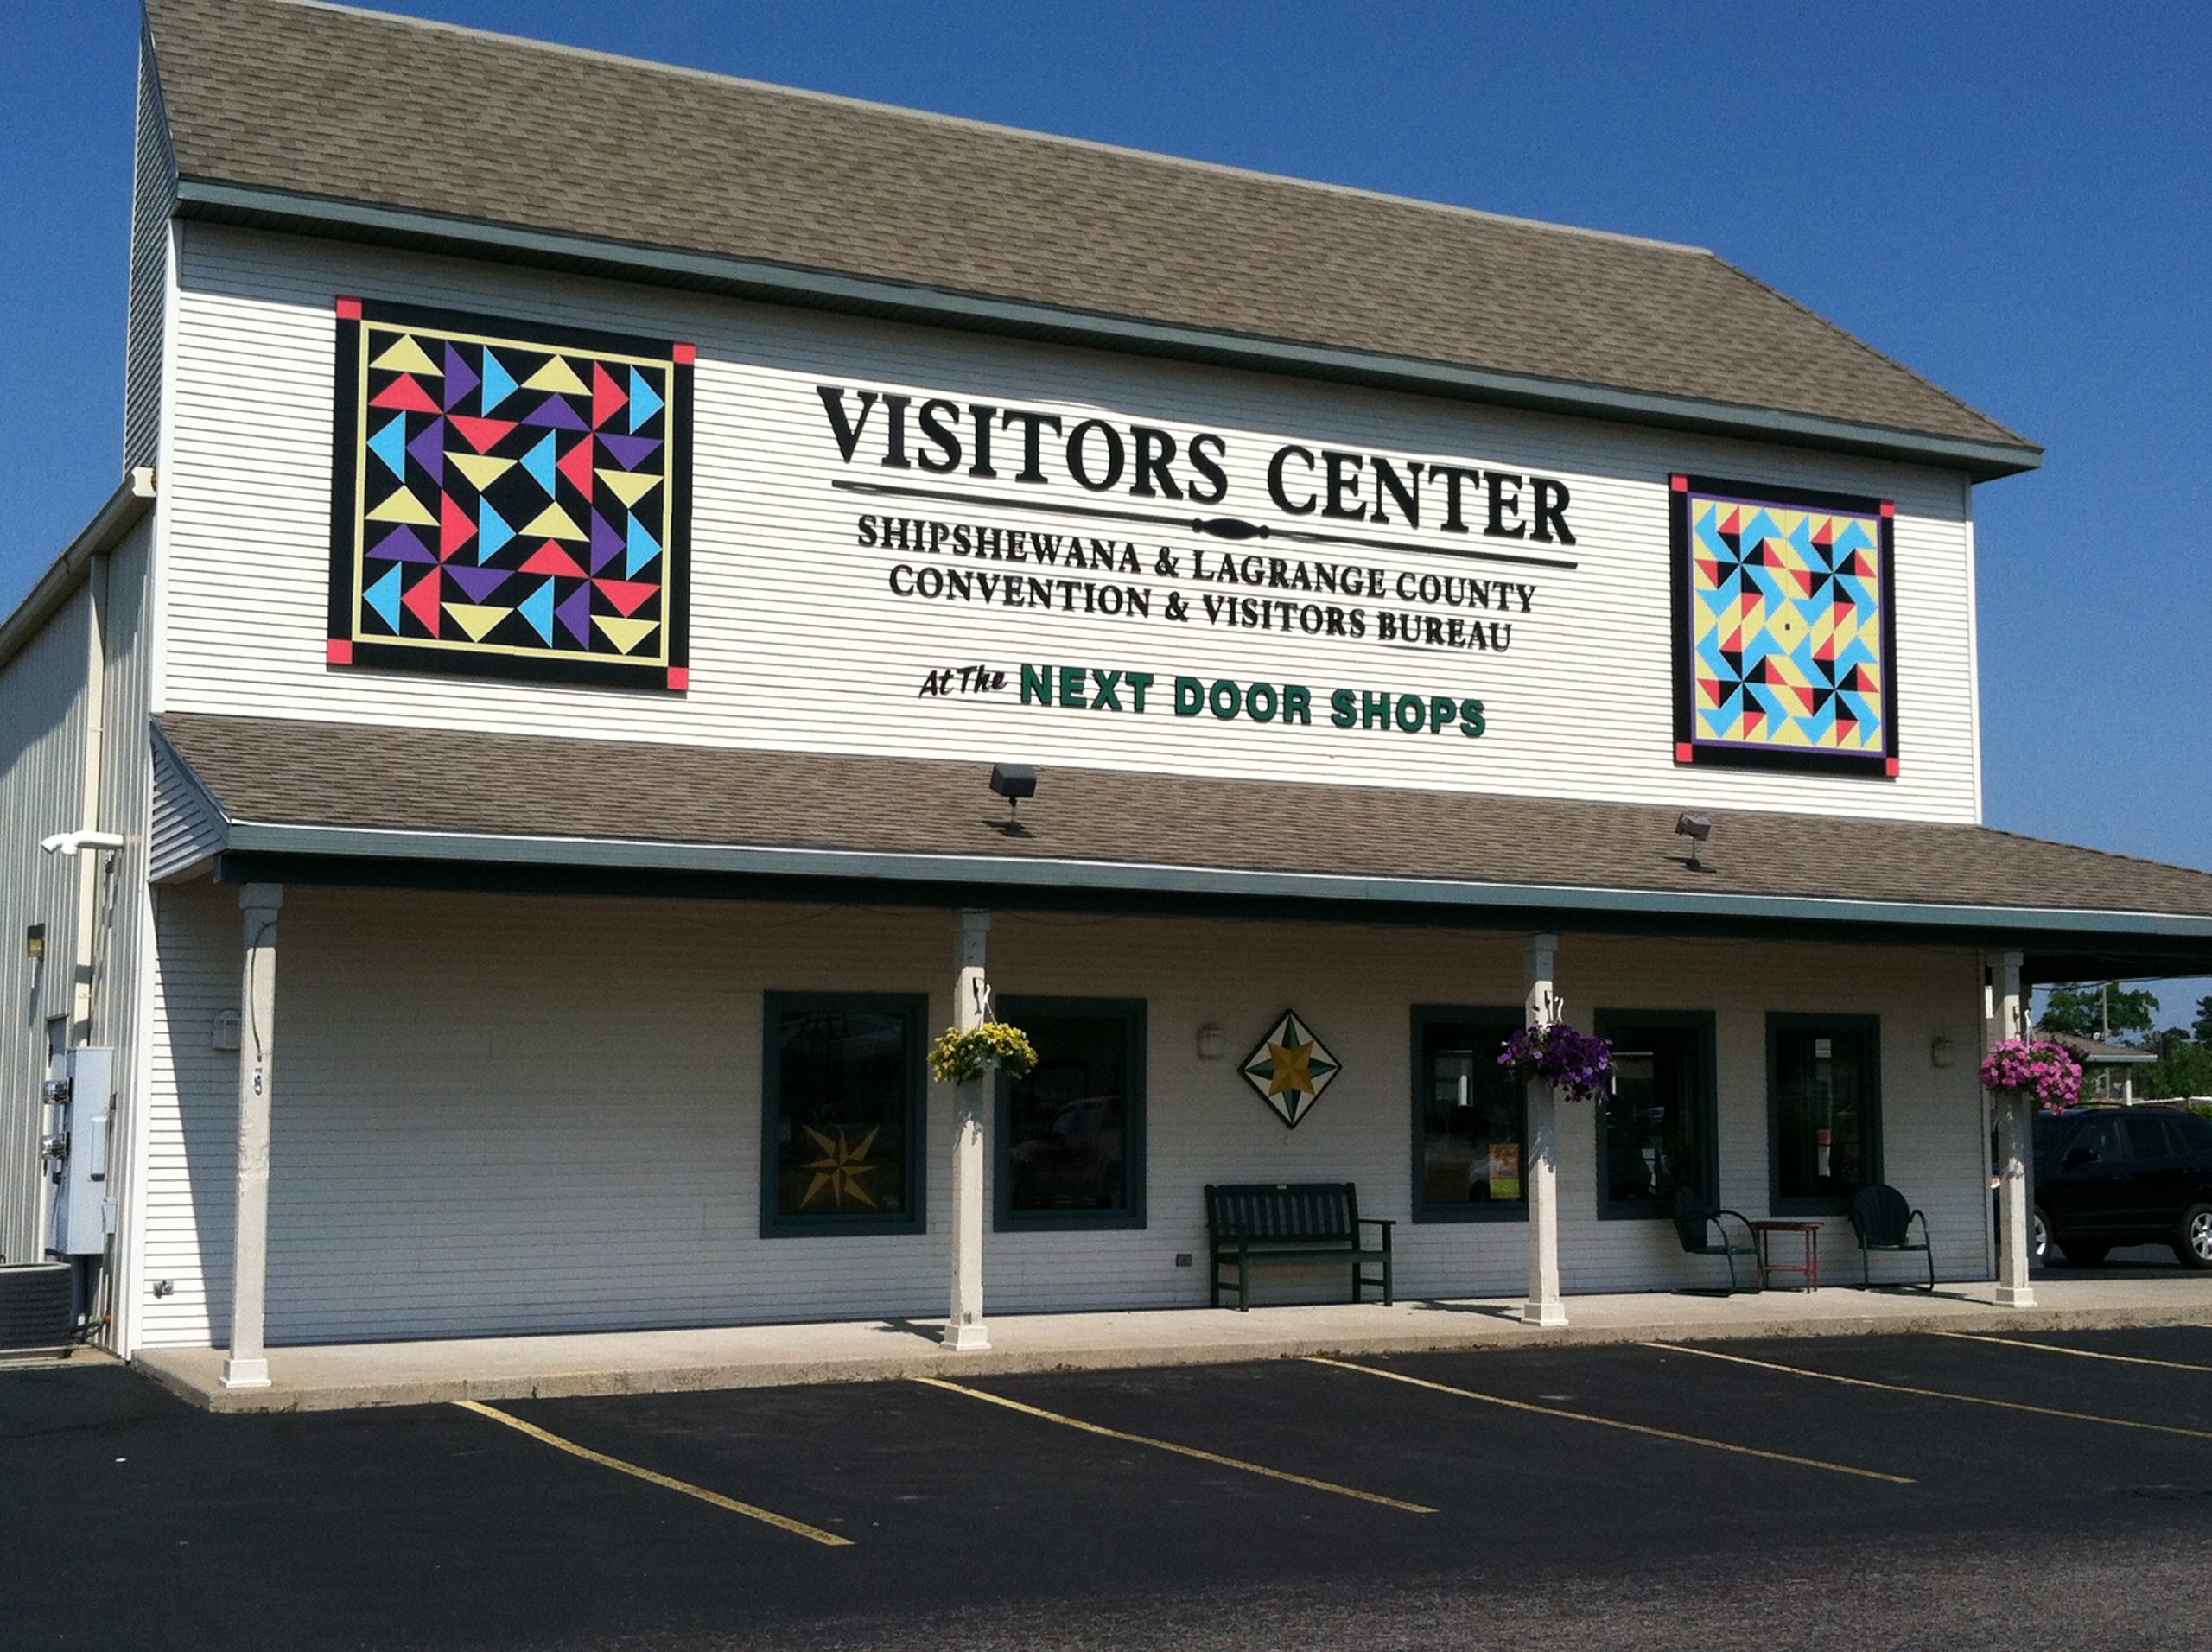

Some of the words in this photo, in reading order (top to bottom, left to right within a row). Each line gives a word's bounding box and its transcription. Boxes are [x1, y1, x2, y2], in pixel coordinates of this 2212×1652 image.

[817, 384, 1228, 505] VISITORS
[1267, 444, 1577, 546] CENTER
[858, 514, 1141, 575] SHIPSHEWANA
[1154, 546, 1179, 577] &
[1192, 549, 1386, 598] LAGRANGE
[1396, 571, 1536, 613] COUNTY
[889, 564, 1152, 619] CONVENTION
[1165, 591, 1189, 622] &
[1202, 594, 1366, 638] VISITORS
[1377, 611, 1512, 652] BUREAU
[1020, 663, 1154, 713] NEXT
[1174, 676, 1312, 725] DOOR
[1331, 689, 1486, 738] SHOPS
